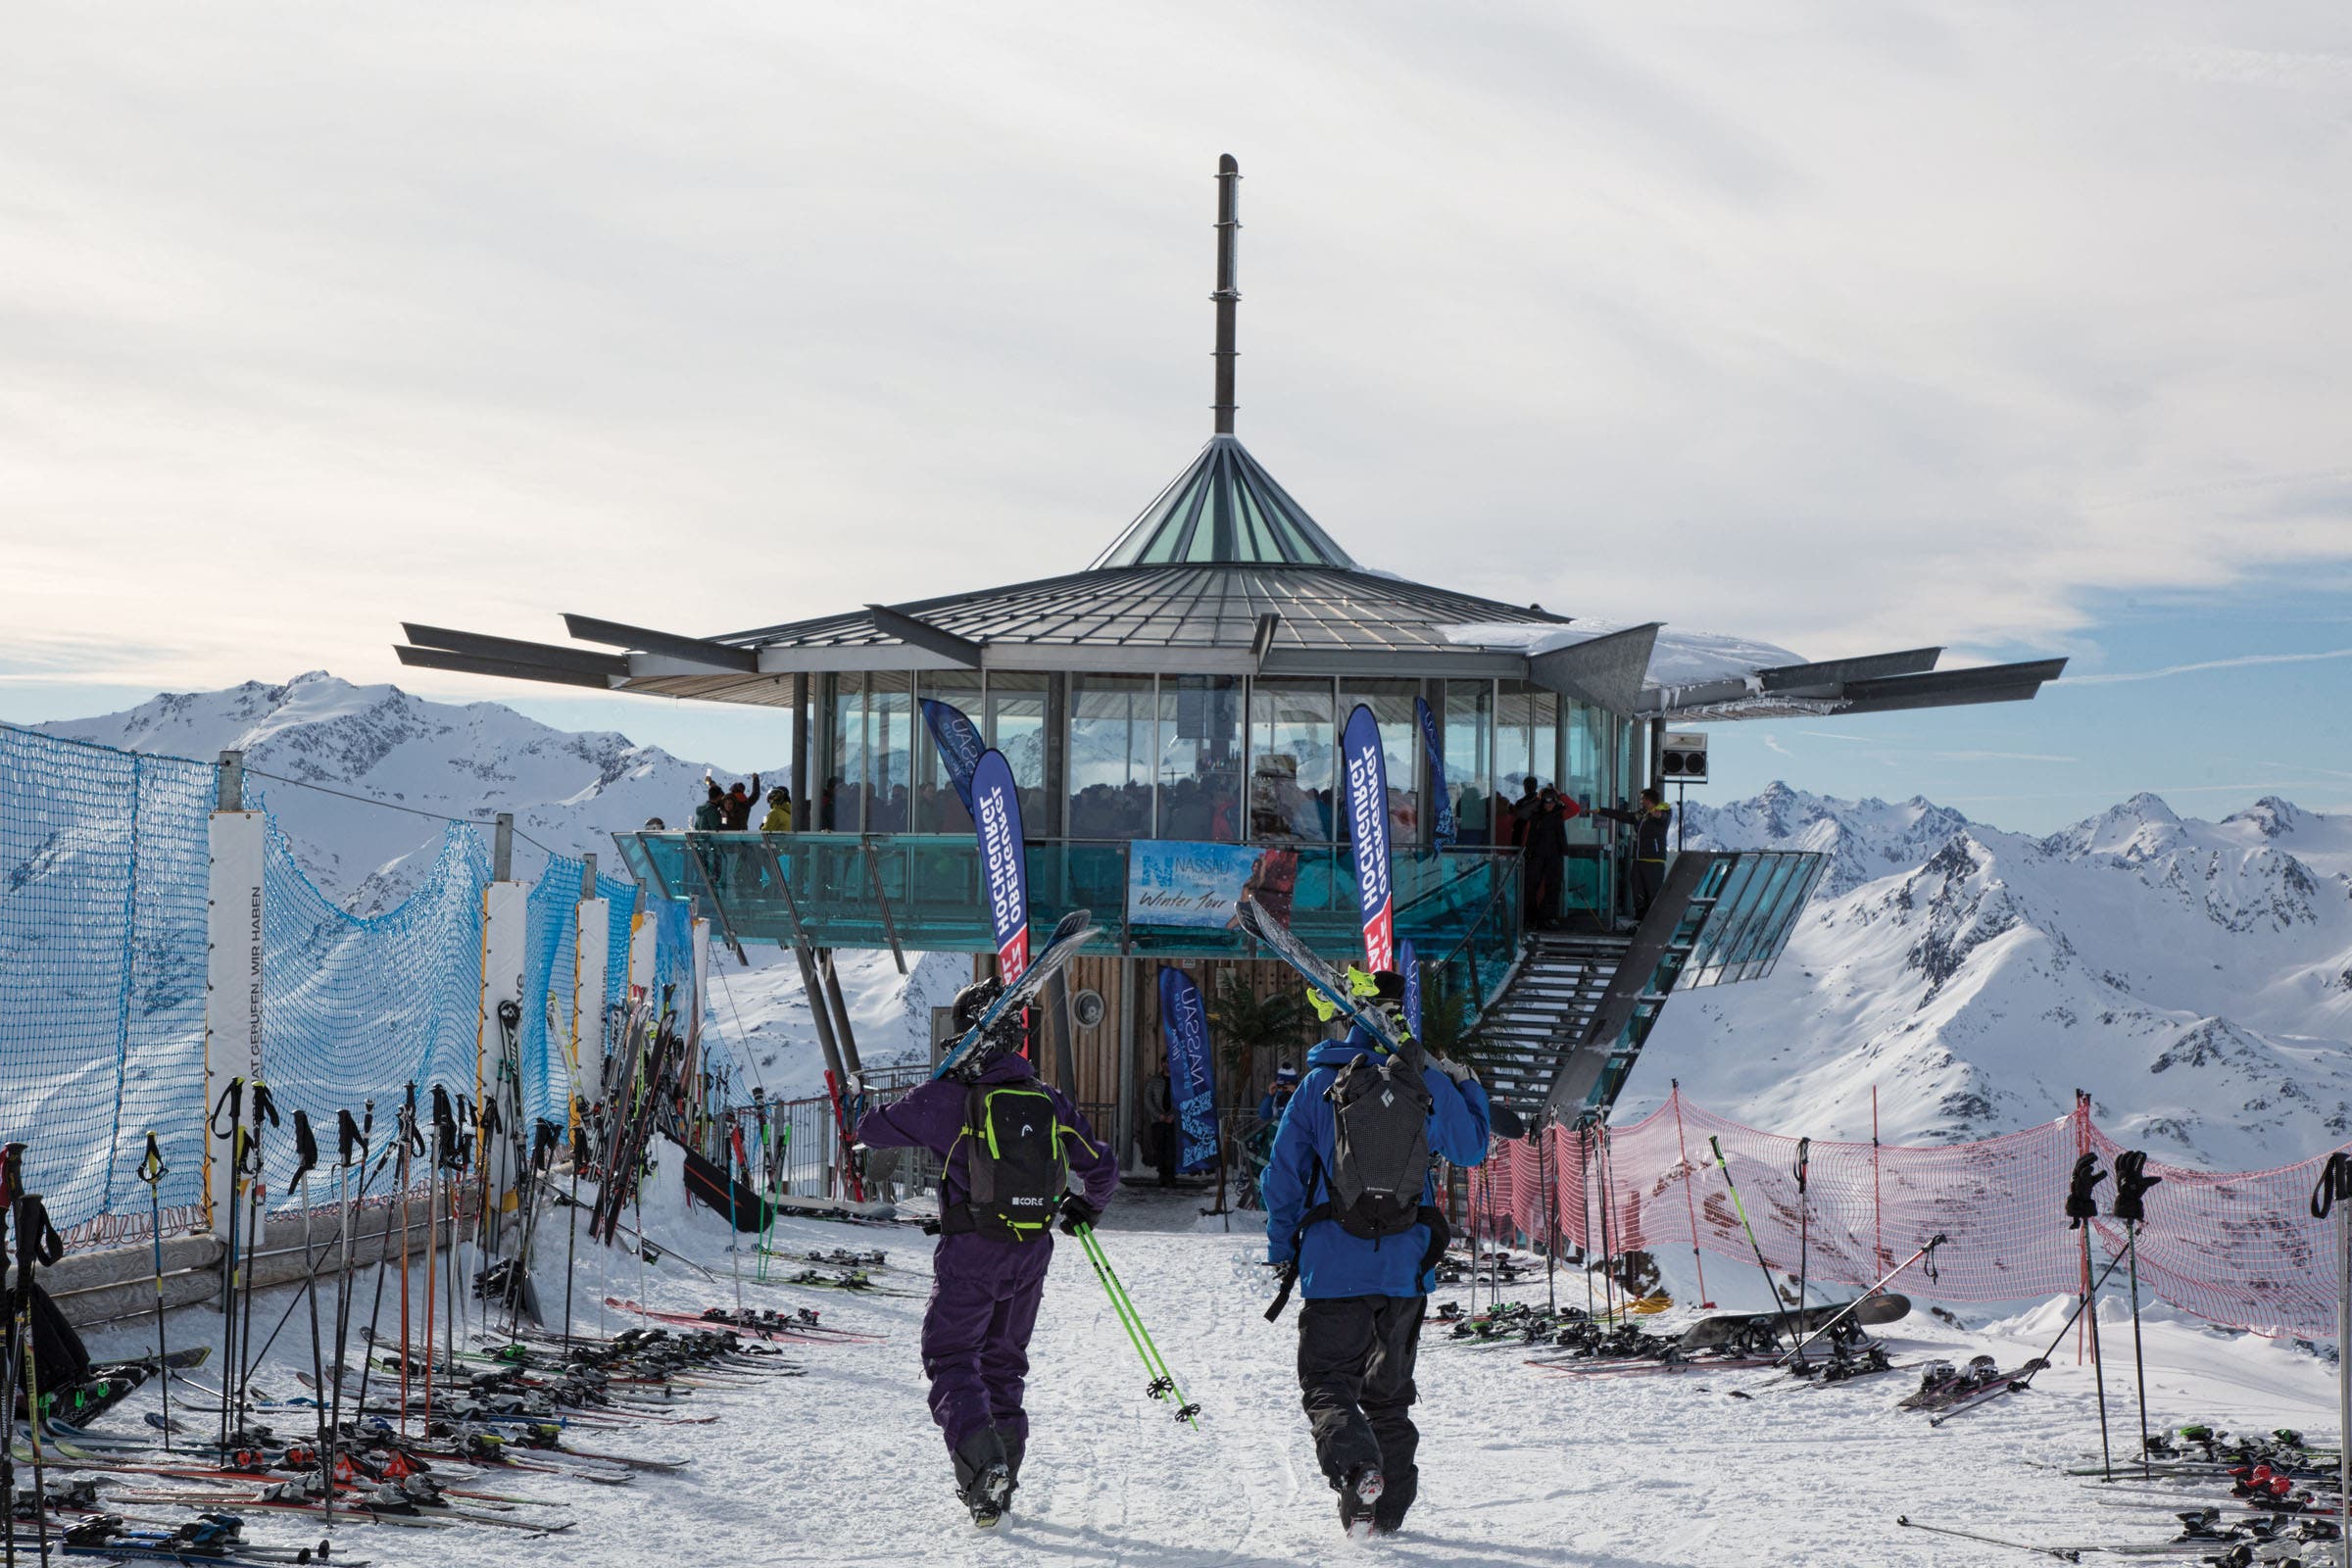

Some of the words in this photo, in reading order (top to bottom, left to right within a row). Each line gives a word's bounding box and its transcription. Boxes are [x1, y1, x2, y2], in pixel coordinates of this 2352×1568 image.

[1176, 857, 1231, 876] NASSAU
[251, 886, 261, 941] HABEN
[1139, 890, 1193, 907] Winter
[1195, 890, 1228, 911] Tour
[251, 945, 261, 976] WIR
